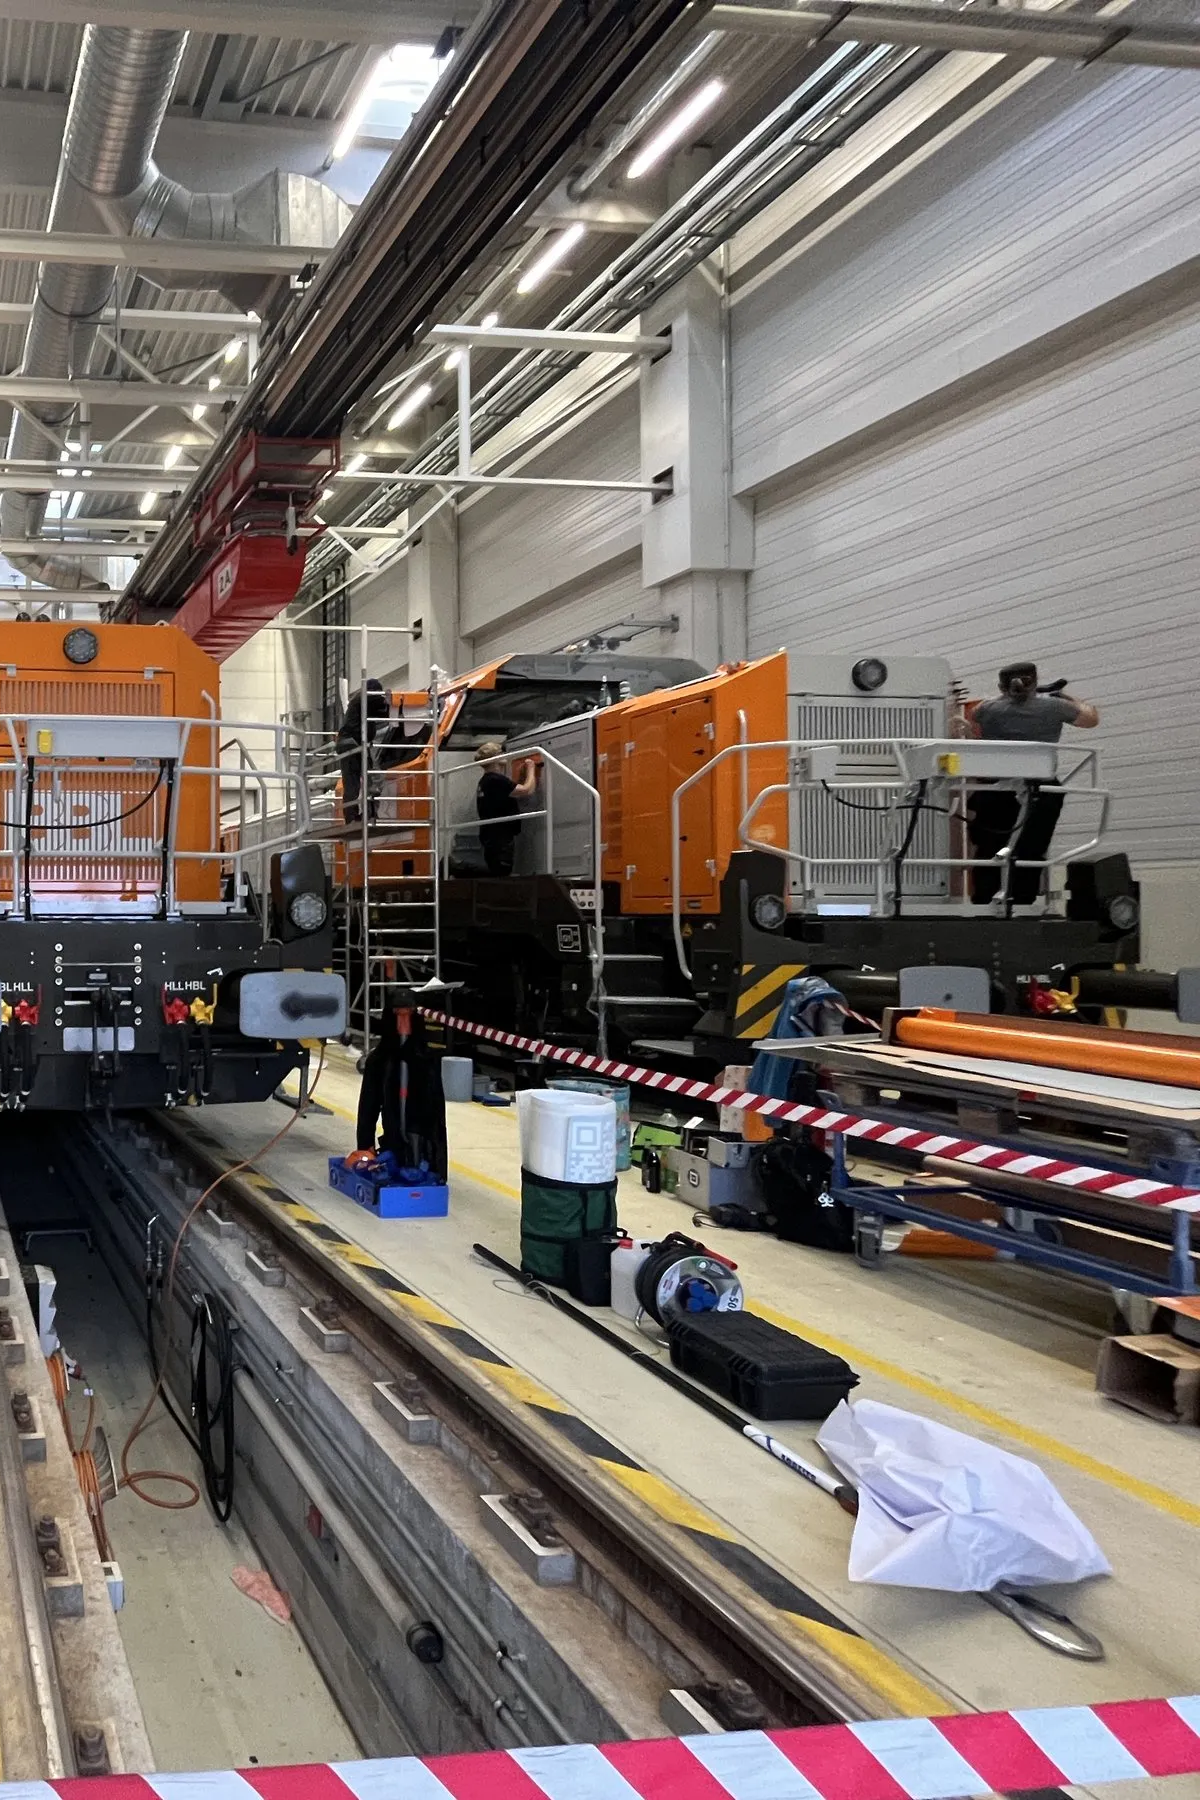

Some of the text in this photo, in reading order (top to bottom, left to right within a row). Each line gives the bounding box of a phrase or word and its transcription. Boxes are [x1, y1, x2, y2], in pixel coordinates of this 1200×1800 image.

[7, 793, 153, 851] BBL
[13, 981, 34, 992] HLL
[164, 980, 207, 991] HLL HBL
